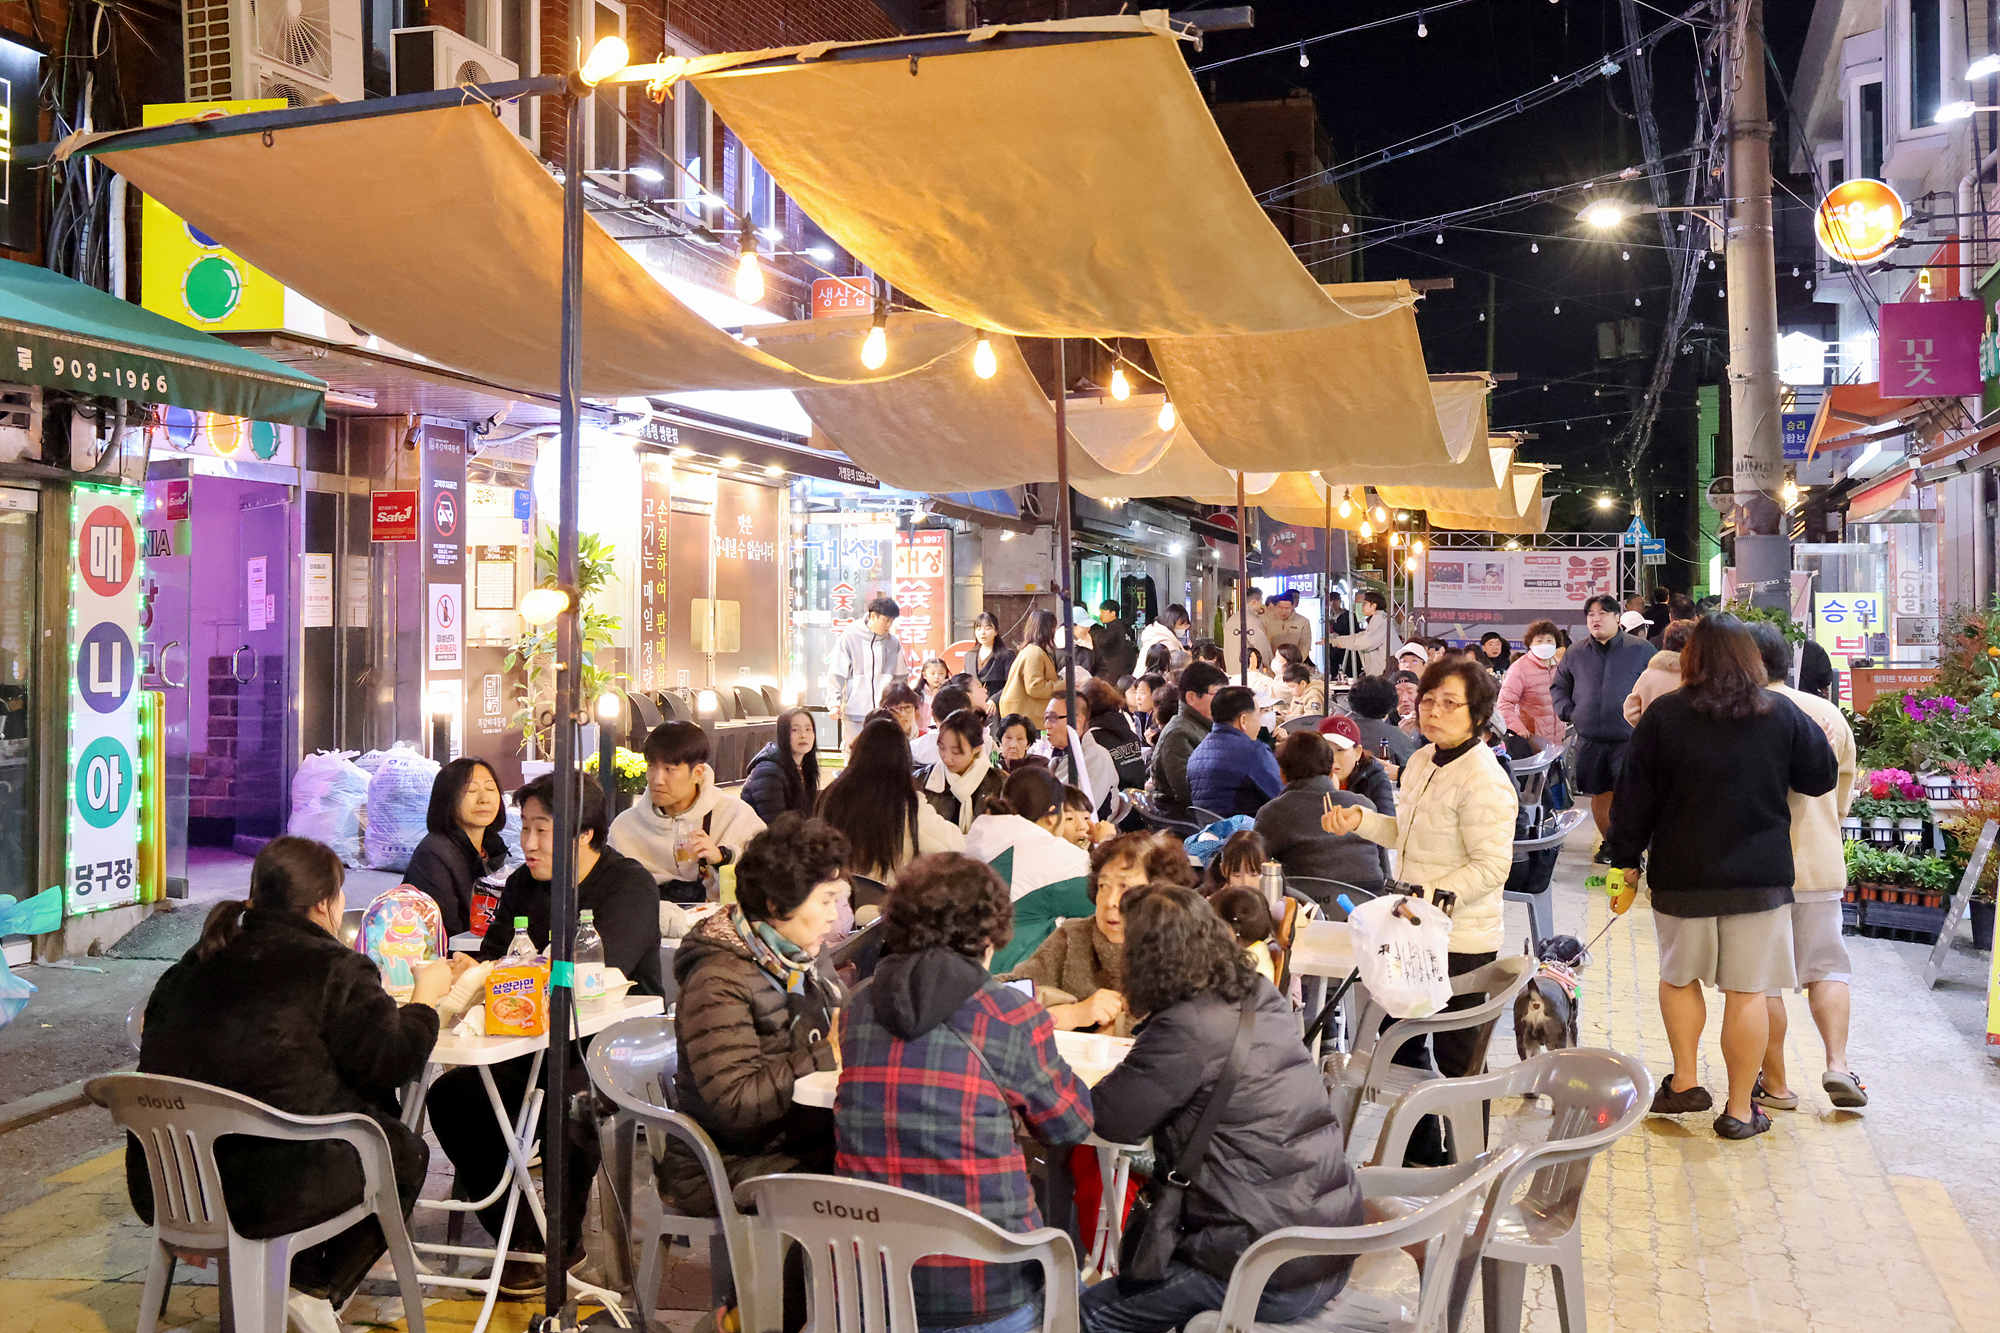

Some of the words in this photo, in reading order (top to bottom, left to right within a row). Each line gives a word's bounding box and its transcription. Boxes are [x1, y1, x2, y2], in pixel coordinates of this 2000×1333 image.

[53, 356, 168, 394] 903-1966
[1897, 339, 1940, 387] 꽃
[1786, 420, 1806, 431] 승리
[643, 498, 655, 569] 고기는
[737, 513, 754, 535] 맛은
[922, 535, 943, 544] 1997
[656, 499, 668, 603] 손질하여
[737, 539, 746, 560] 수
[747, 540, 775, 563] 없습니다
[643, 580, 654, 632] 매일
[1820, 599, 1878, 623] 승원
[642, 639, 654, 691] 정량
[655, 611, 667, 688] 판매합
[86, 524, 124, 814] 매니아
[1897, 675, 1919, 683] TAKE
[75, 857, 133, 897] 당구장
[492, 977, 535, 996] 삼양라면
[137, 1095, 185, 1112] cloud
[812, 1199, 881, 1224] cloud
